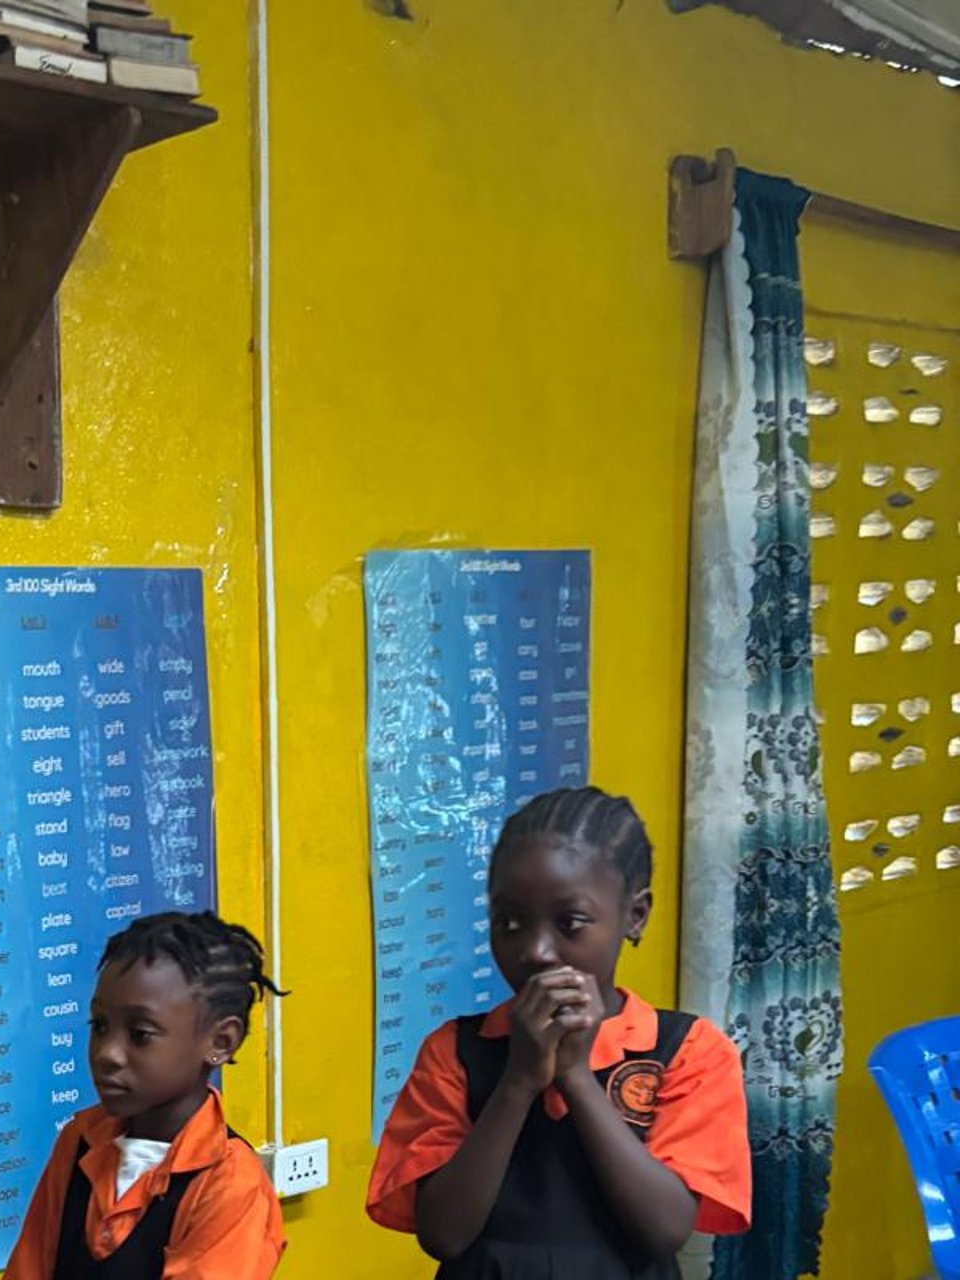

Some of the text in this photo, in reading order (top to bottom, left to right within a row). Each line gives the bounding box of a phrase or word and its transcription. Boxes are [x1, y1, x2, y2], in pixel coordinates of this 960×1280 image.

[5, 576, 23, 593] 3rd
[40, 576, 65, 597] Sight
[65, 576, 97, 593] Words
[23, 660, 61, 676] mouth
[23, 694, 65, 712] tongue
[95, 690, 131, 708] goods
[21, 725, 71, 741] students
[104, 720, 125, 739] gift
[32, 756, 63, 776] eight
[27, 787, 72, 806] triangle
[35, 818, 68, 836] stand
[38, 850, 68, 868] baby
[41, 912, 72, 932] plate
[38, 942, 78, 960] square
[43, 999, 79, 1018] cousin
[52, 1056, 76, 1076] God
[51, 1087, 79, 1105] keep
